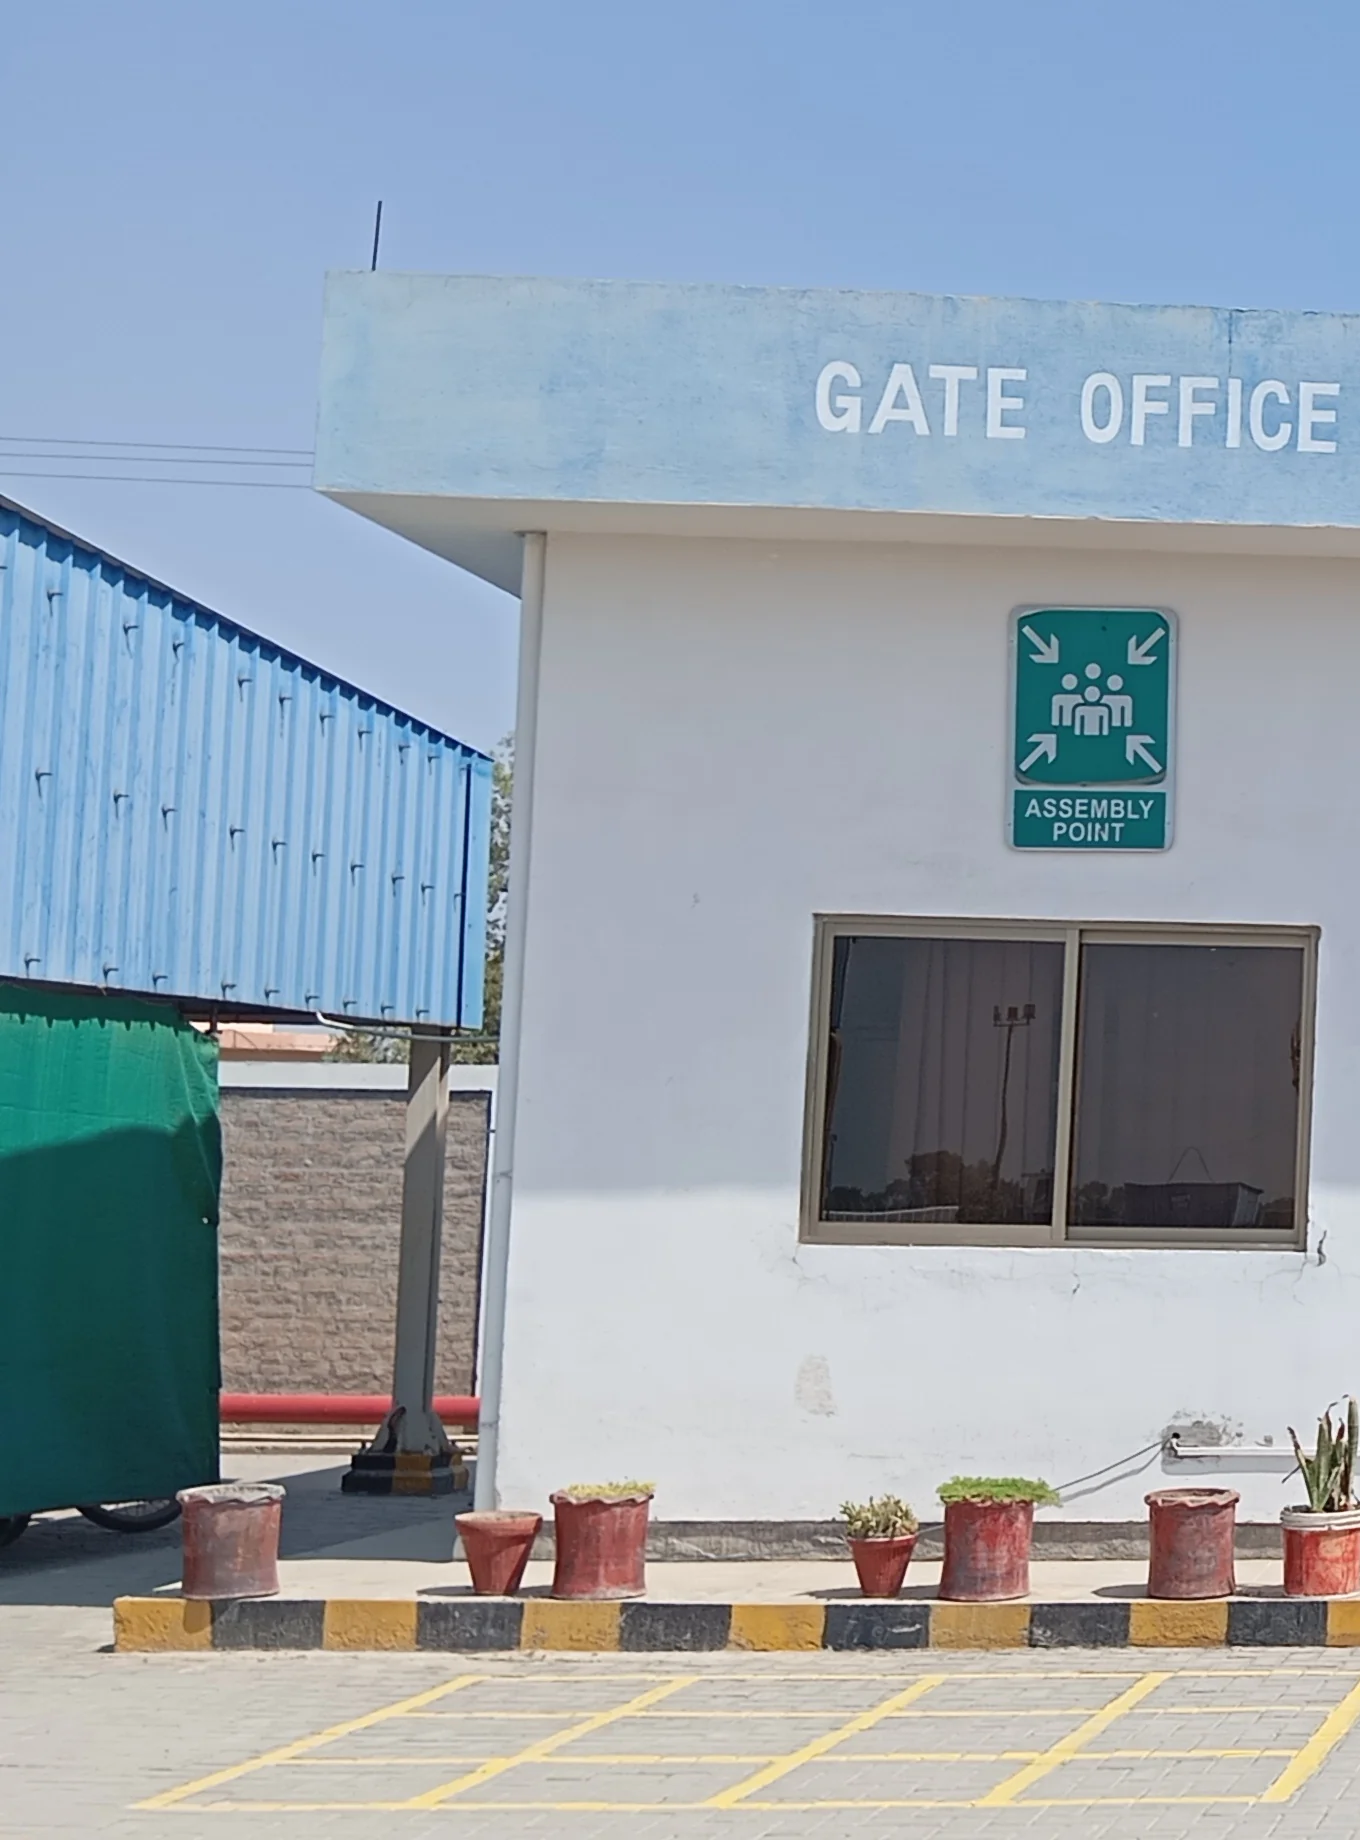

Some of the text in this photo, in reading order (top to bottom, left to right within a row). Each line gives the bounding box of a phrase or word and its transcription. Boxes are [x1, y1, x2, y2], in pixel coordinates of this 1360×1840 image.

[816, 360, 1341, 454] GATE OFFICE
[1024, 798, 1155, 819] ASSEMBLY
[1053, 822, 1125, 842] POINT
